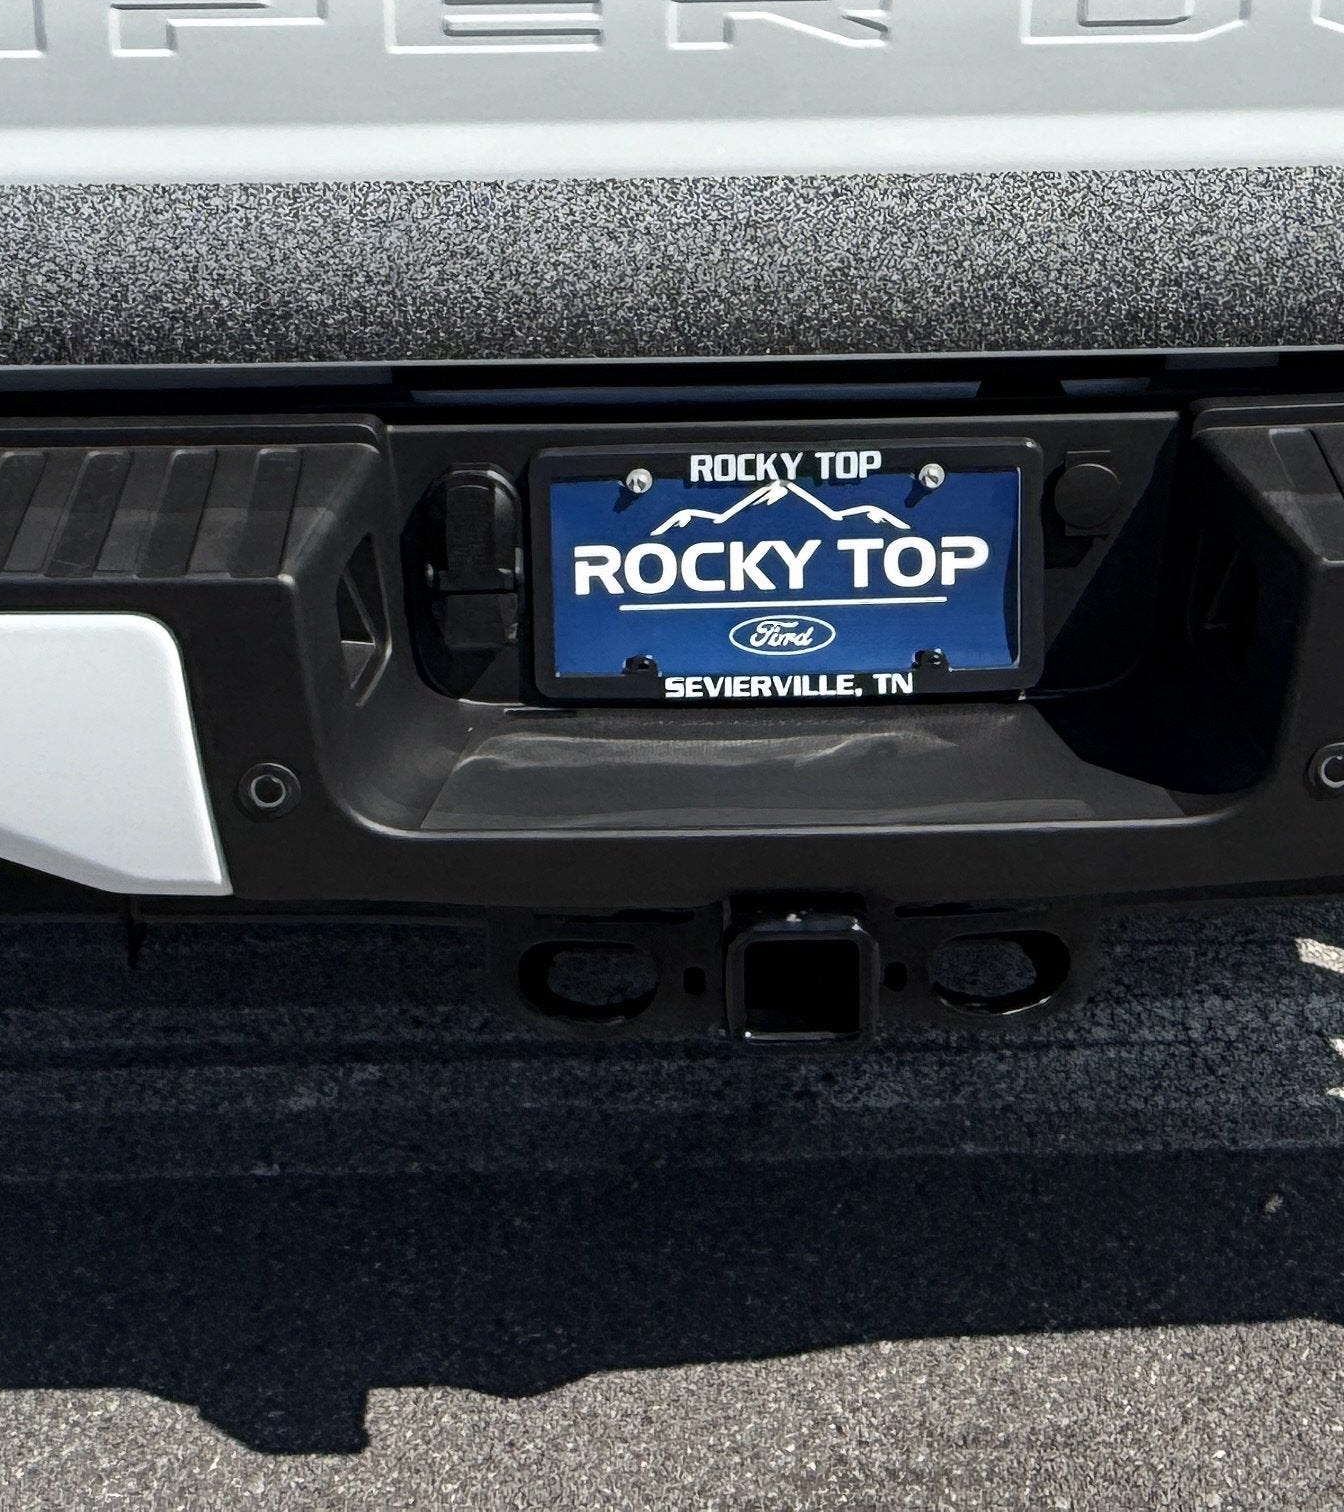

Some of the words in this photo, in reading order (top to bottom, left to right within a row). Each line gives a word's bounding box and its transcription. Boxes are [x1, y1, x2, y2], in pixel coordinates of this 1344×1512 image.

[689, 451, 804, 483] ROCKY
[814, 450, 882, 481] TOP
[573, 539, 822, 596] ROCKY
[837, 535, 990, 589] TOP
[749, 620, 815, 648] Ford
[664, 673, 863, 699] SEVIERVILLE,
[873, 672, 914, 696] TN
